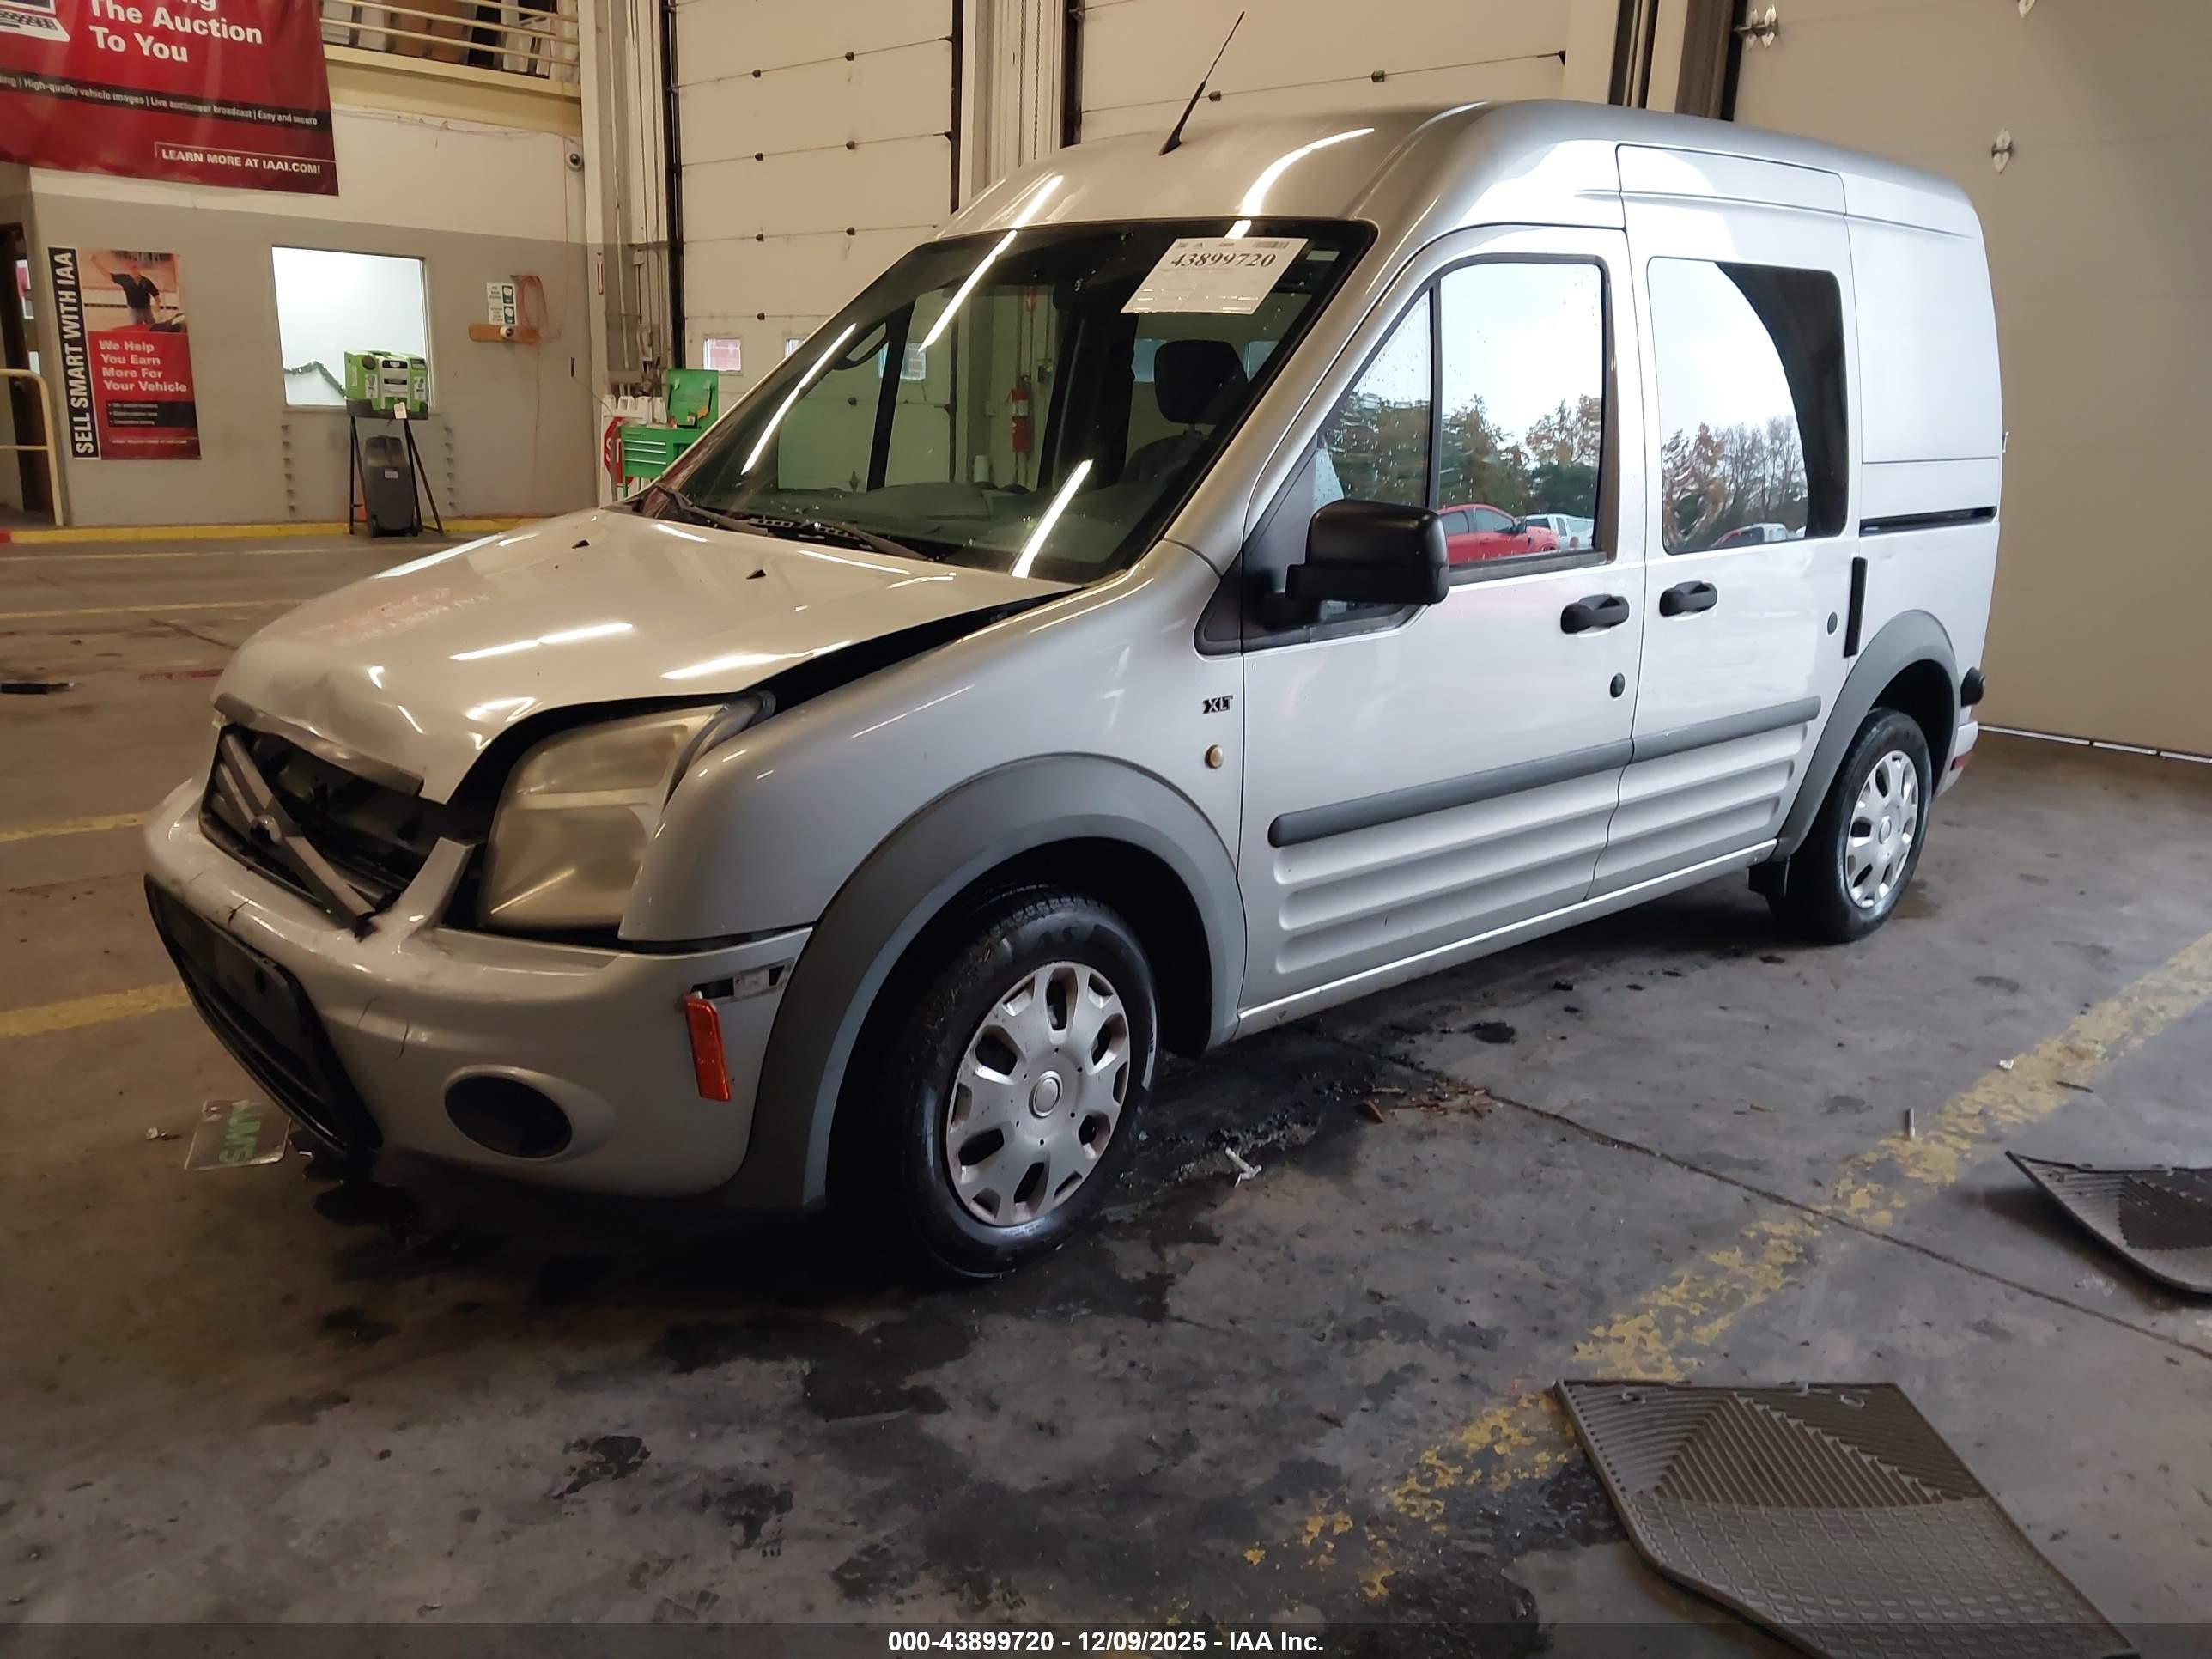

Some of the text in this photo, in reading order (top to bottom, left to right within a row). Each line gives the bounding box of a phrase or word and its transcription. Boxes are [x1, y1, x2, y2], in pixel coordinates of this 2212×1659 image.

[91, 0, 263, 44] The Auction
[89, 25, 188, 62] To You
[24, 78, 78, 96] High-quality
[80, 88, 111, 100] vehicle
[112, 92, 144, 105] images
[151, 97, 167, 107] Live
[213, 105, 252, 118] broadcast
[258, 110, 276, 123] Easy
[277, 113, 291, 123] and
[161, 149, 320, 174] LEARN MORE AT IAAI.COM!
[1171, 253, 1276, 267] 43899720
[54, 252, 94, 454] SELL SMART WITH IAA
[99, 340, 155, 354] We Help
[100, 354, 161, 365] You Earn
[102, 367, 162, 378] More For
[103, 380, 187, 392] Your Vehicle
[1202, 696, 1233, 714] XLT
